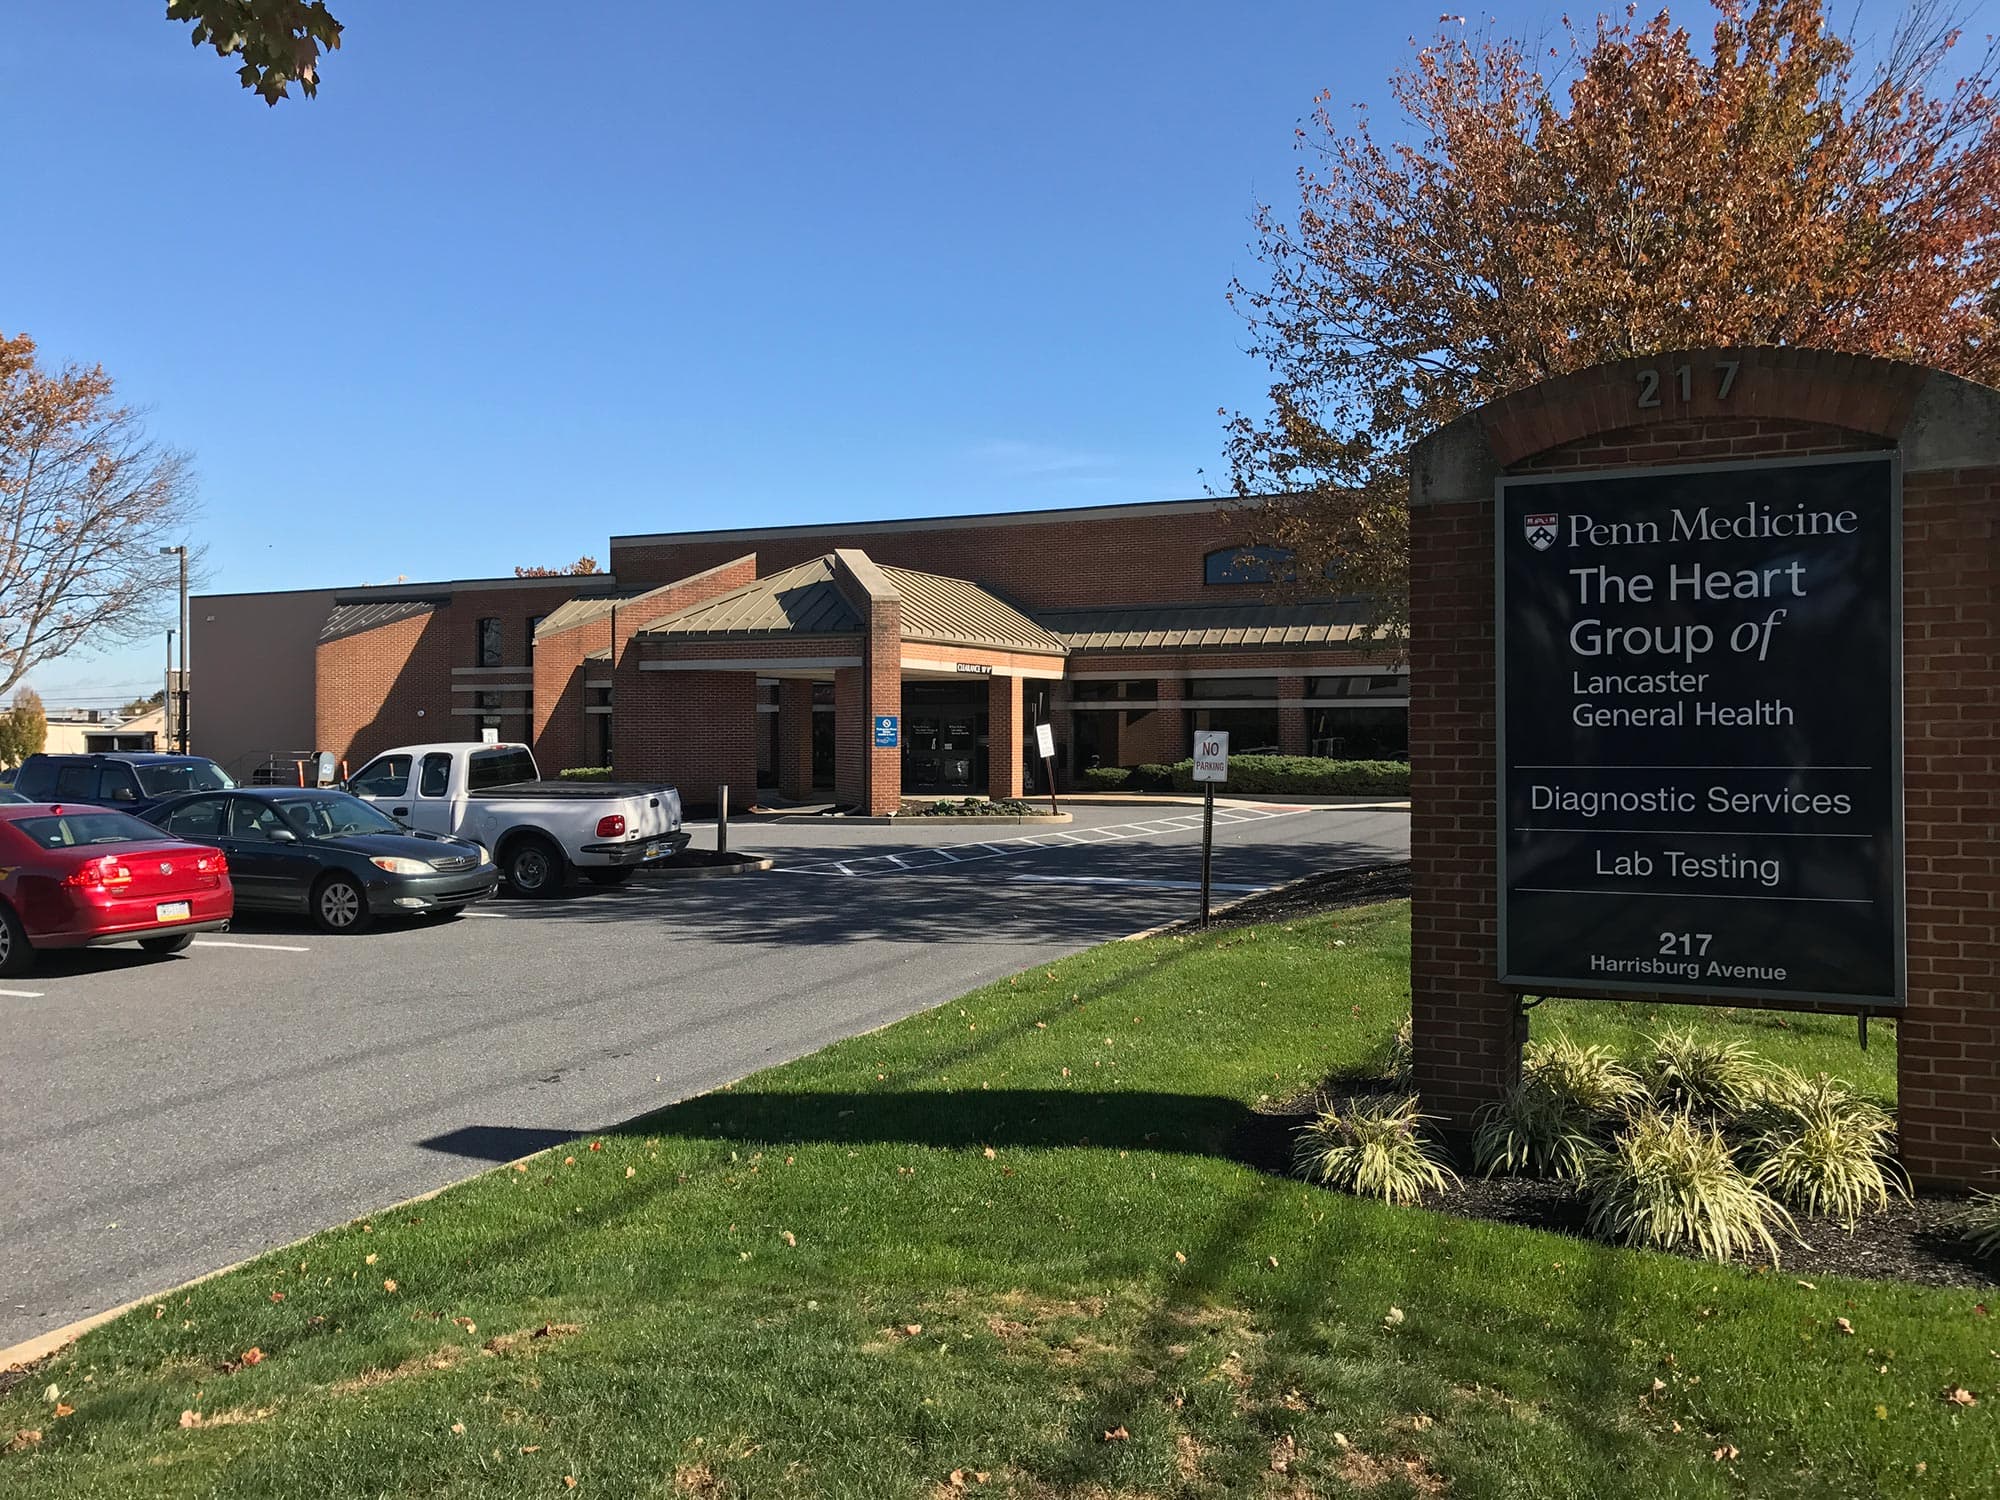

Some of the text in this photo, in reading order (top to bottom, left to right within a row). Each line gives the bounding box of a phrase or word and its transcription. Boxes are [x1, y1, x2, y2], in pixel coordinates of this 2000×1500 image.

[1636, 360, 1740, 408] 217
[1567, 502, 1858, 547] Penn Medicine
[1569, 561, 1807, 604] The Heart
[1569, 608, 1787, 664] Group of
[1573, 670, 1710, 694] Lancaster
[1572, 699, 1794, 727] General Health
[1202, 741, 1220, 756] NO
[1196, 761, 1225, 771] PARKING
[1531, 785, 1852, 816] Diagnostic Services
[1596, 849, 1780, 887] Lab Testing
[1659, 932, 1713, 956] 217
[1590, 955, 1787, 980] Harrisburg Avenue
